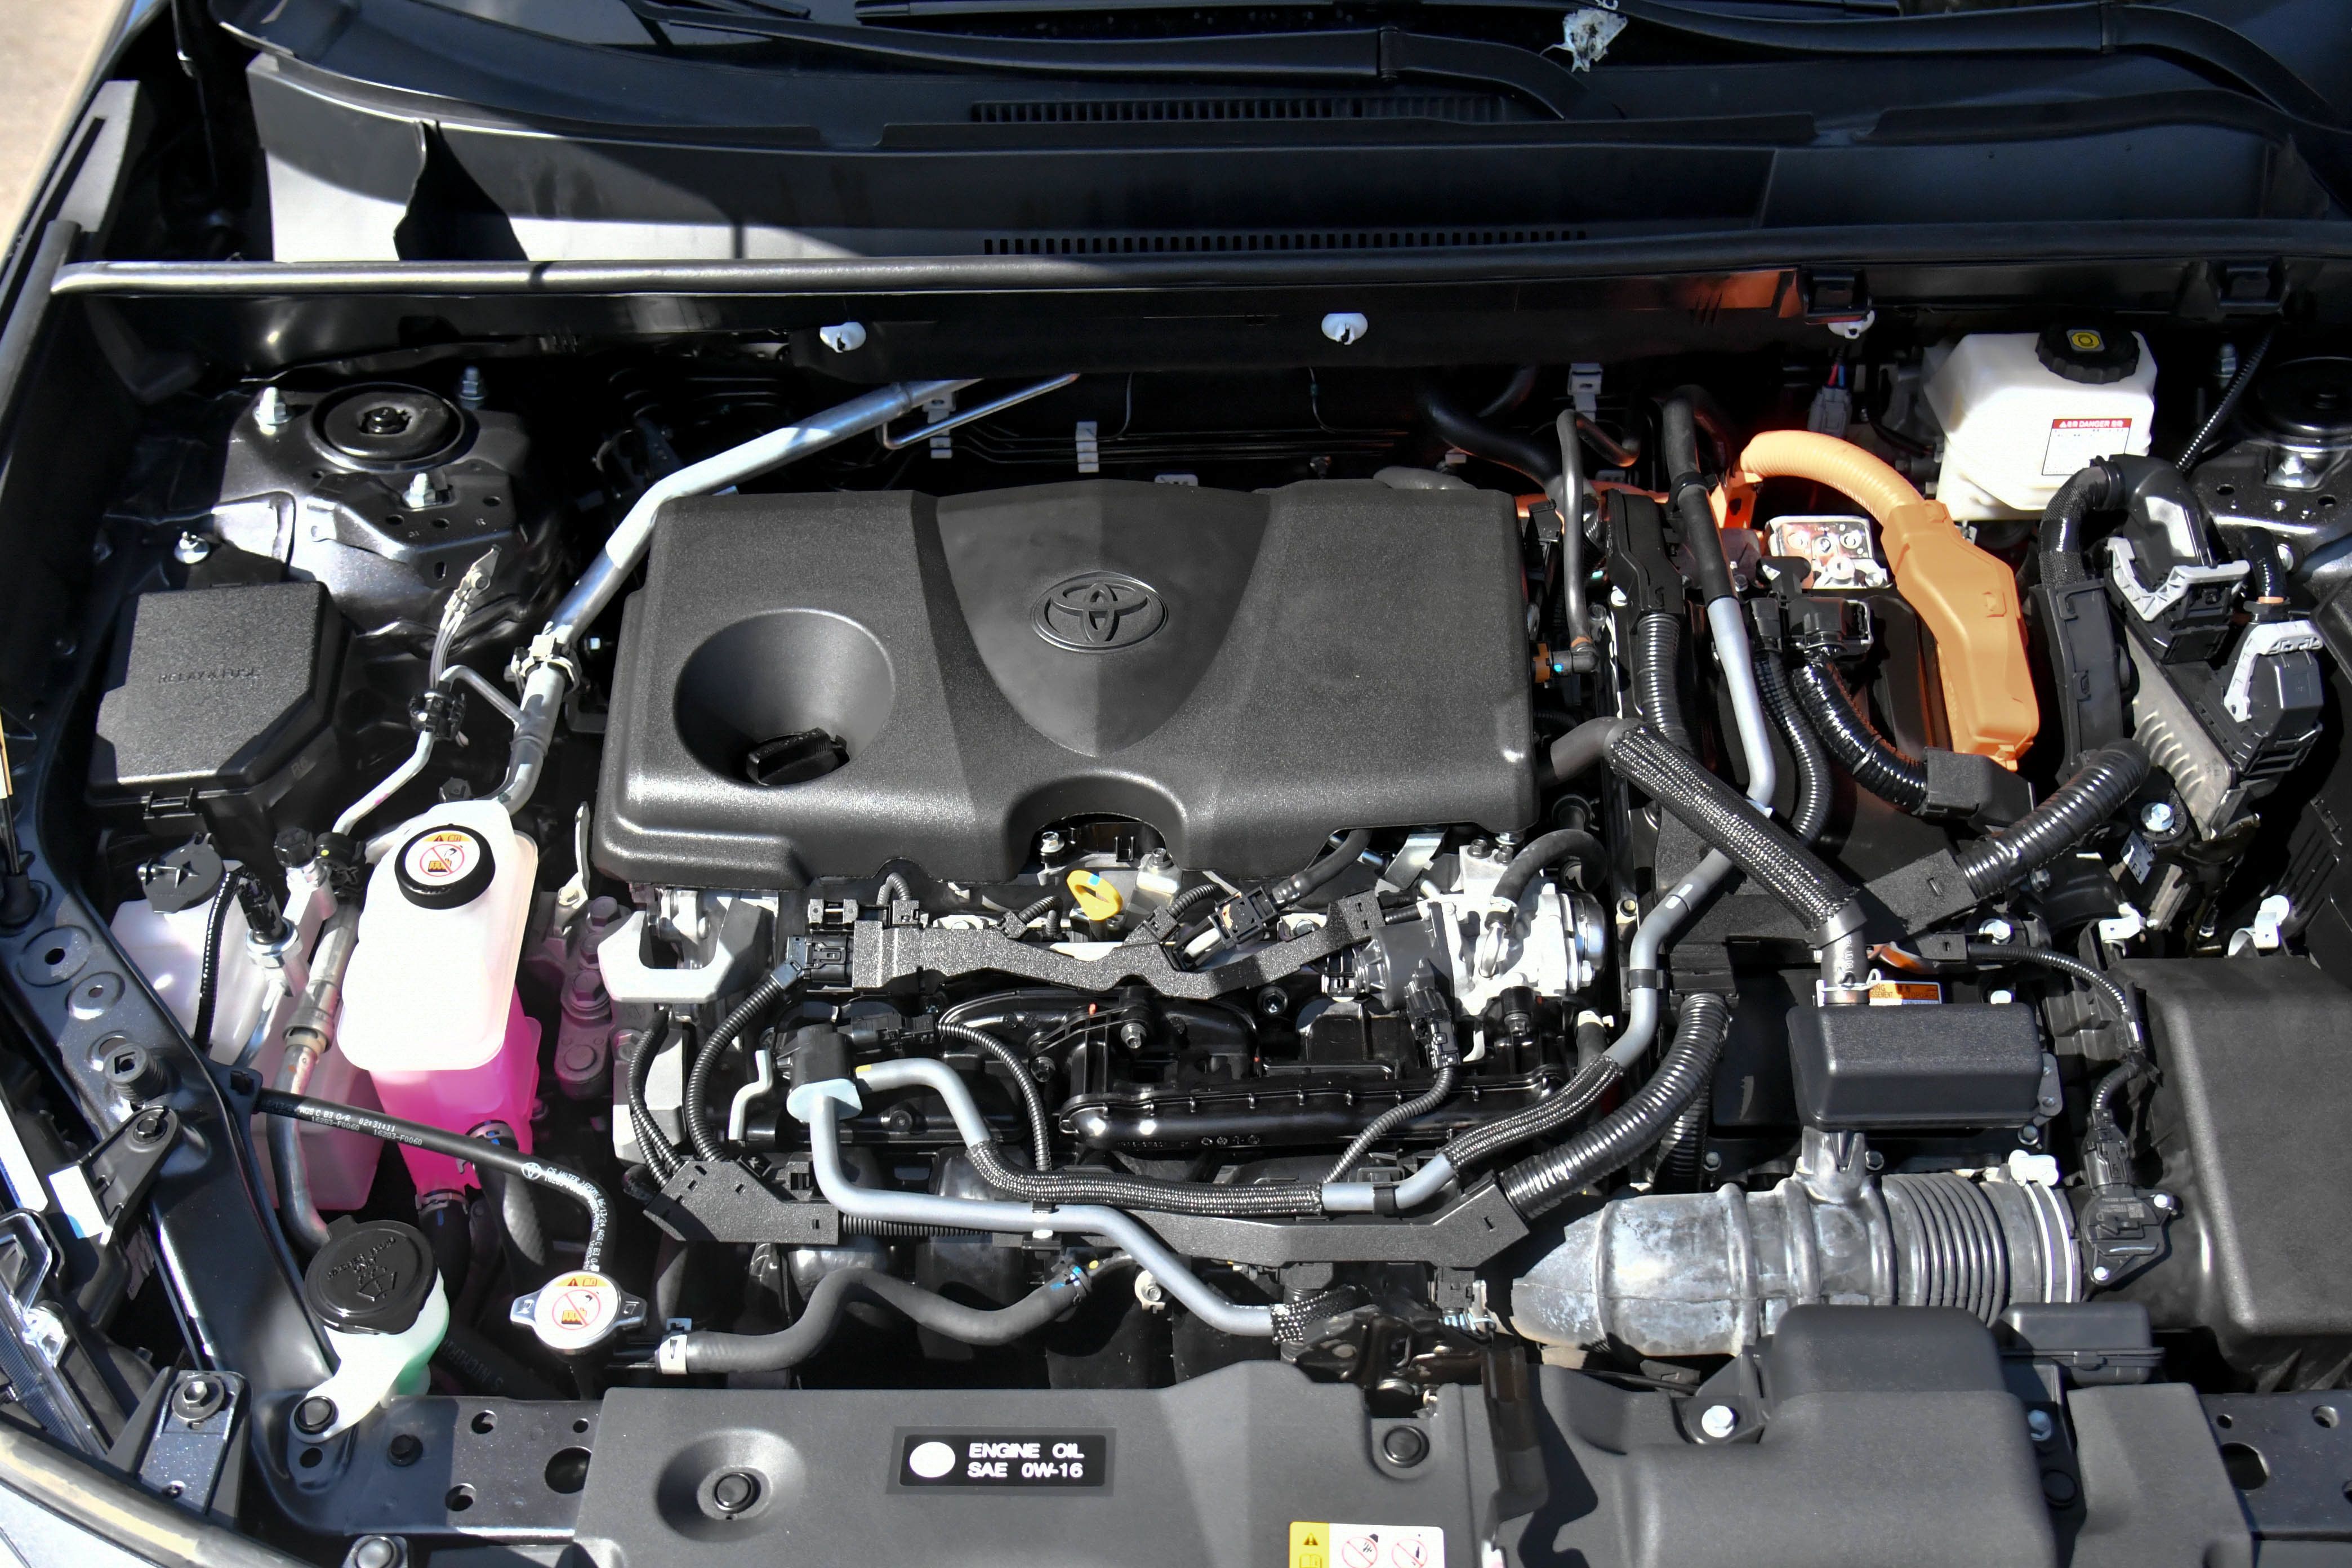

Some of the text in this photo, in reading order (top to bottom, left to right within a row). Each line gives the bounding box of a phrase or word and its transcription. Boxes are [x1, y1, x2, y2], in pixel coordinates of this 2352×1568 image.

[311, 1116, 360, 1132] 16283-F0060
[373, 1129, 422, 1146] 16283-F0060
[969, 1443, 1085, 1458] ENGINE OIL
[968, 1462, 1084, 1477] SAE 0W-16
